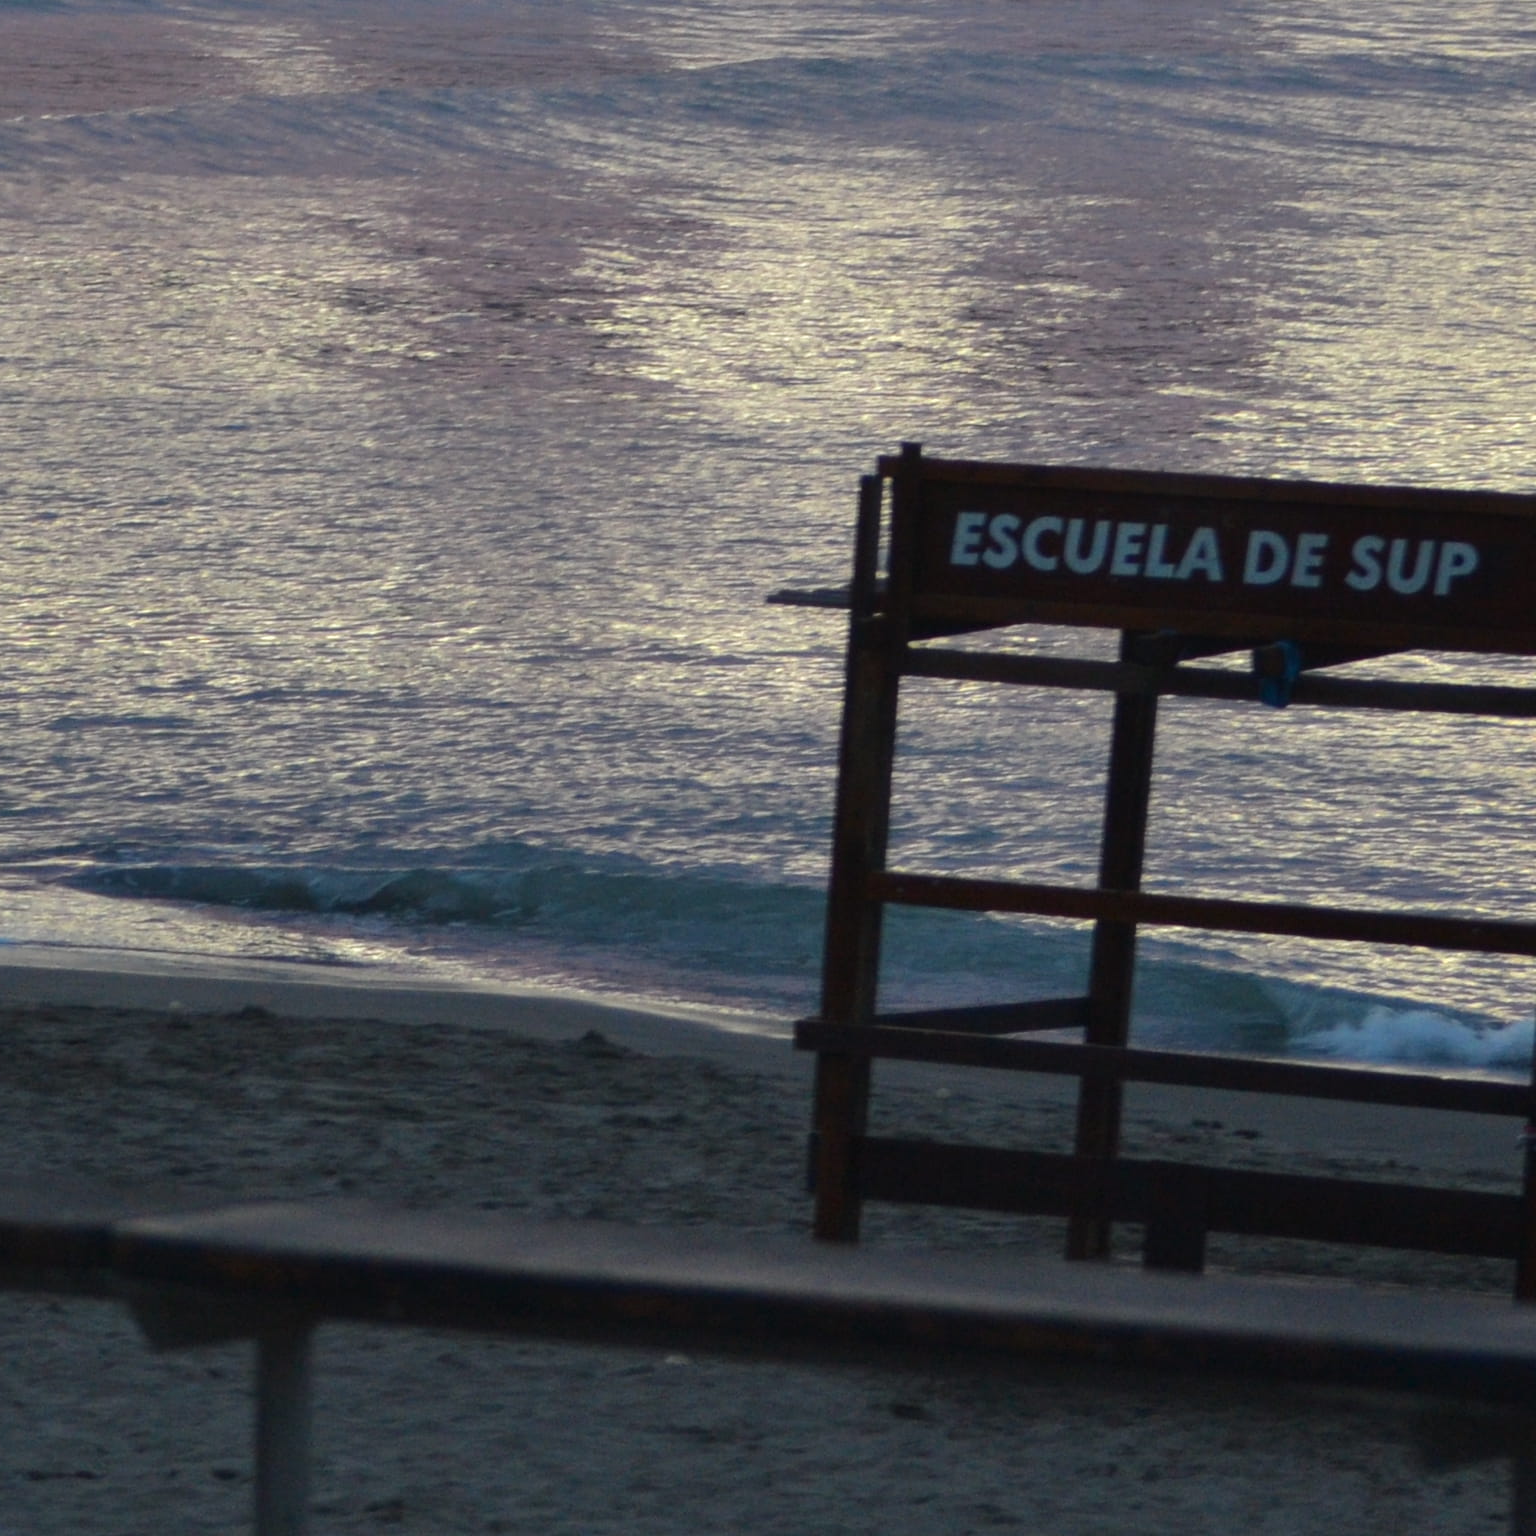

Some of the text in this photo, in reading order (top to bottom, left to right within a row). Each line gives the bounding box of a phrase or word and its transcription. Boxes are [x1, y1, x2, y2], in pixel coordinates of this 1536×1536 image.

[950, 511, 1479, 596] ESCUELA DE SUP
